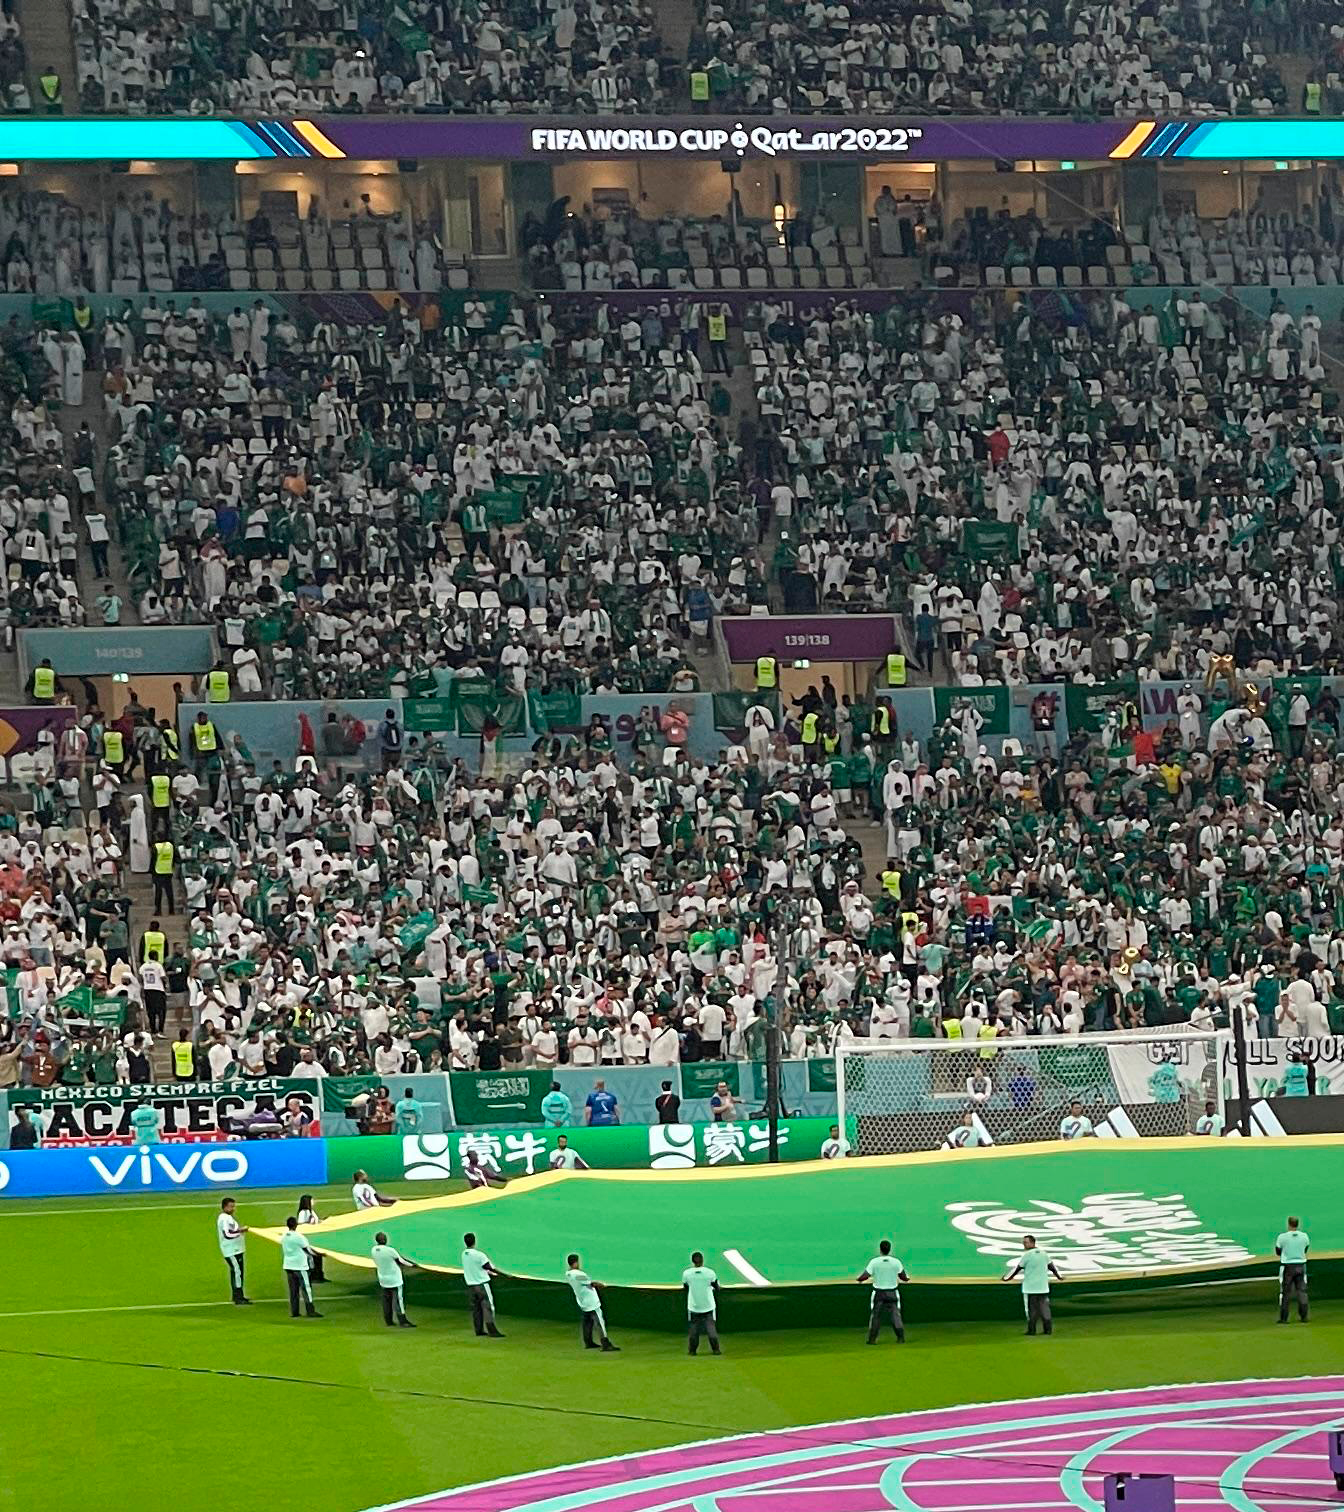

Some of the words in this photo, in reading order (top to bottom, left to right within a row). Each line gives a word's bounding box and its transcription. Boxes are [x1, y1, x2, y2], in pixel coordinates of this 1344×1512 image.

[532, 129, 587, 151] FIFA
[587, 129, 677, 151] WORLD
[679, 129, 735, 151] CUP
[129, 1081, 225, 1099] SIEMPRE
[230, 1079, 284, 1093] FIEL
[459, 1132, 547, 1175] 蒙牛
[703, 1123, 789, 1164] 蒙牛
[89, 1145, 249, 1186] vivo
